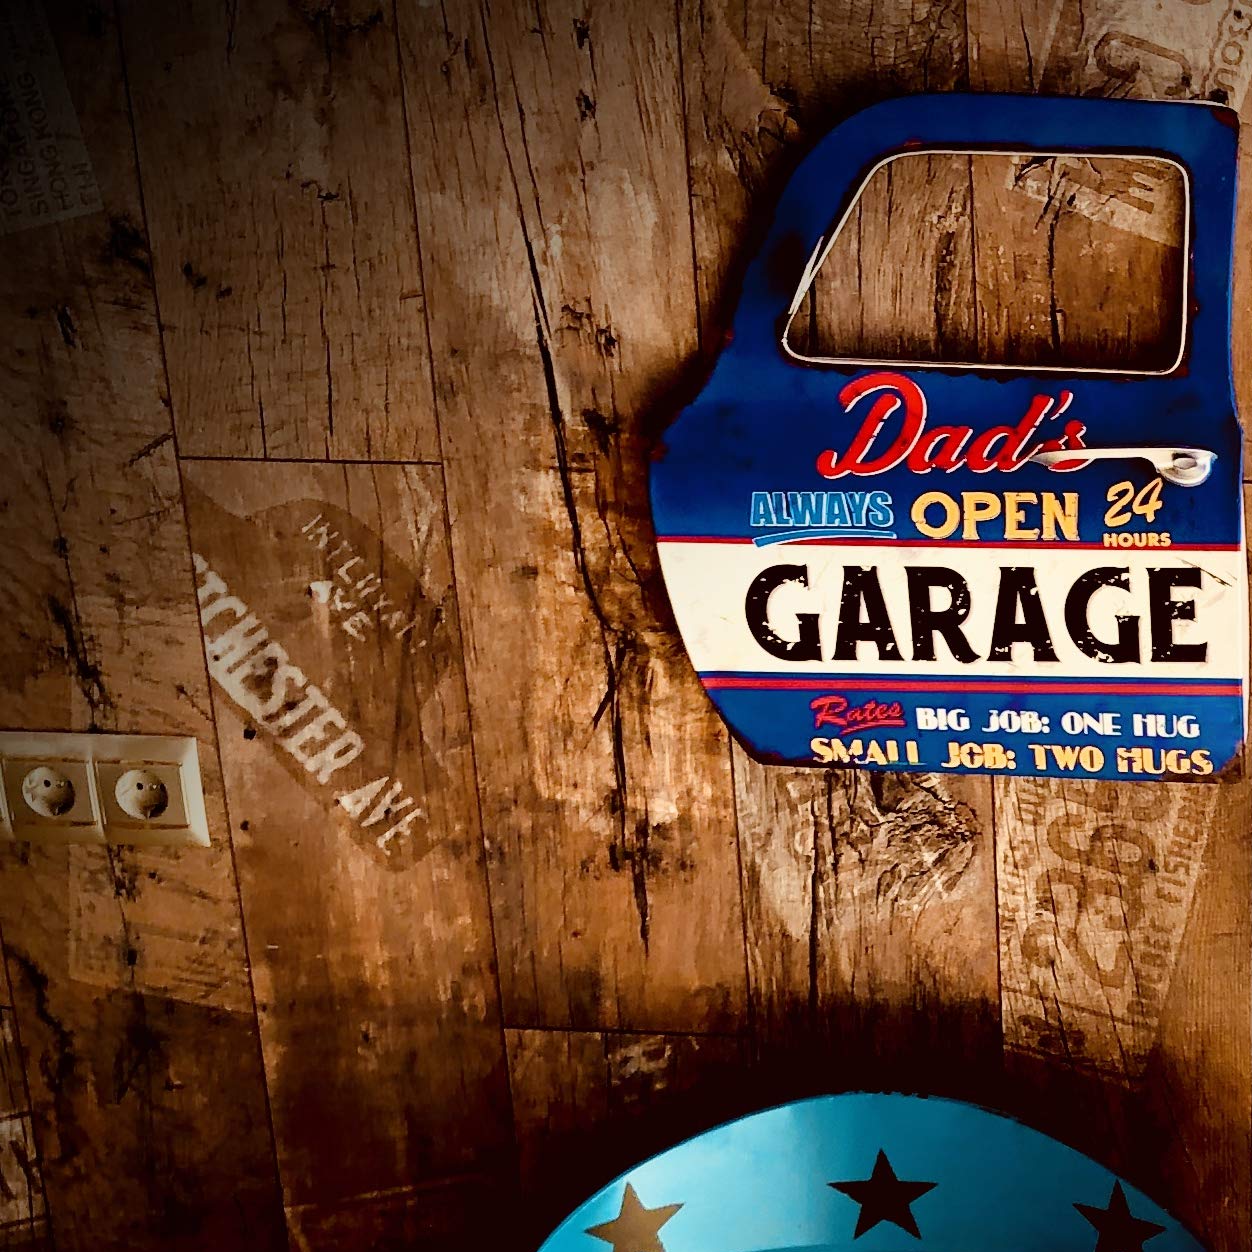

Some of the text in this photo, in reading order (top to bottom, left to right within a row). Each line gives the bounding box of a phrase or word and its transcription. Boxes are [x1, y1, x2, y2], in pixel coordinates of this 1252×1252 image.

[816, 373, 1093, 478] Dad's
[750, 477, 1165, 541] ALWAYS OPEN 24
[1103, 533, 1172, 548] HOURS
[745, 563, 1209, 665] GARAGE
[809, 695, 1200, 739] Rates BIG JOB: ONE HUG
[810, 737, 1216, 776] SMALL JOB: TWO HUGS
